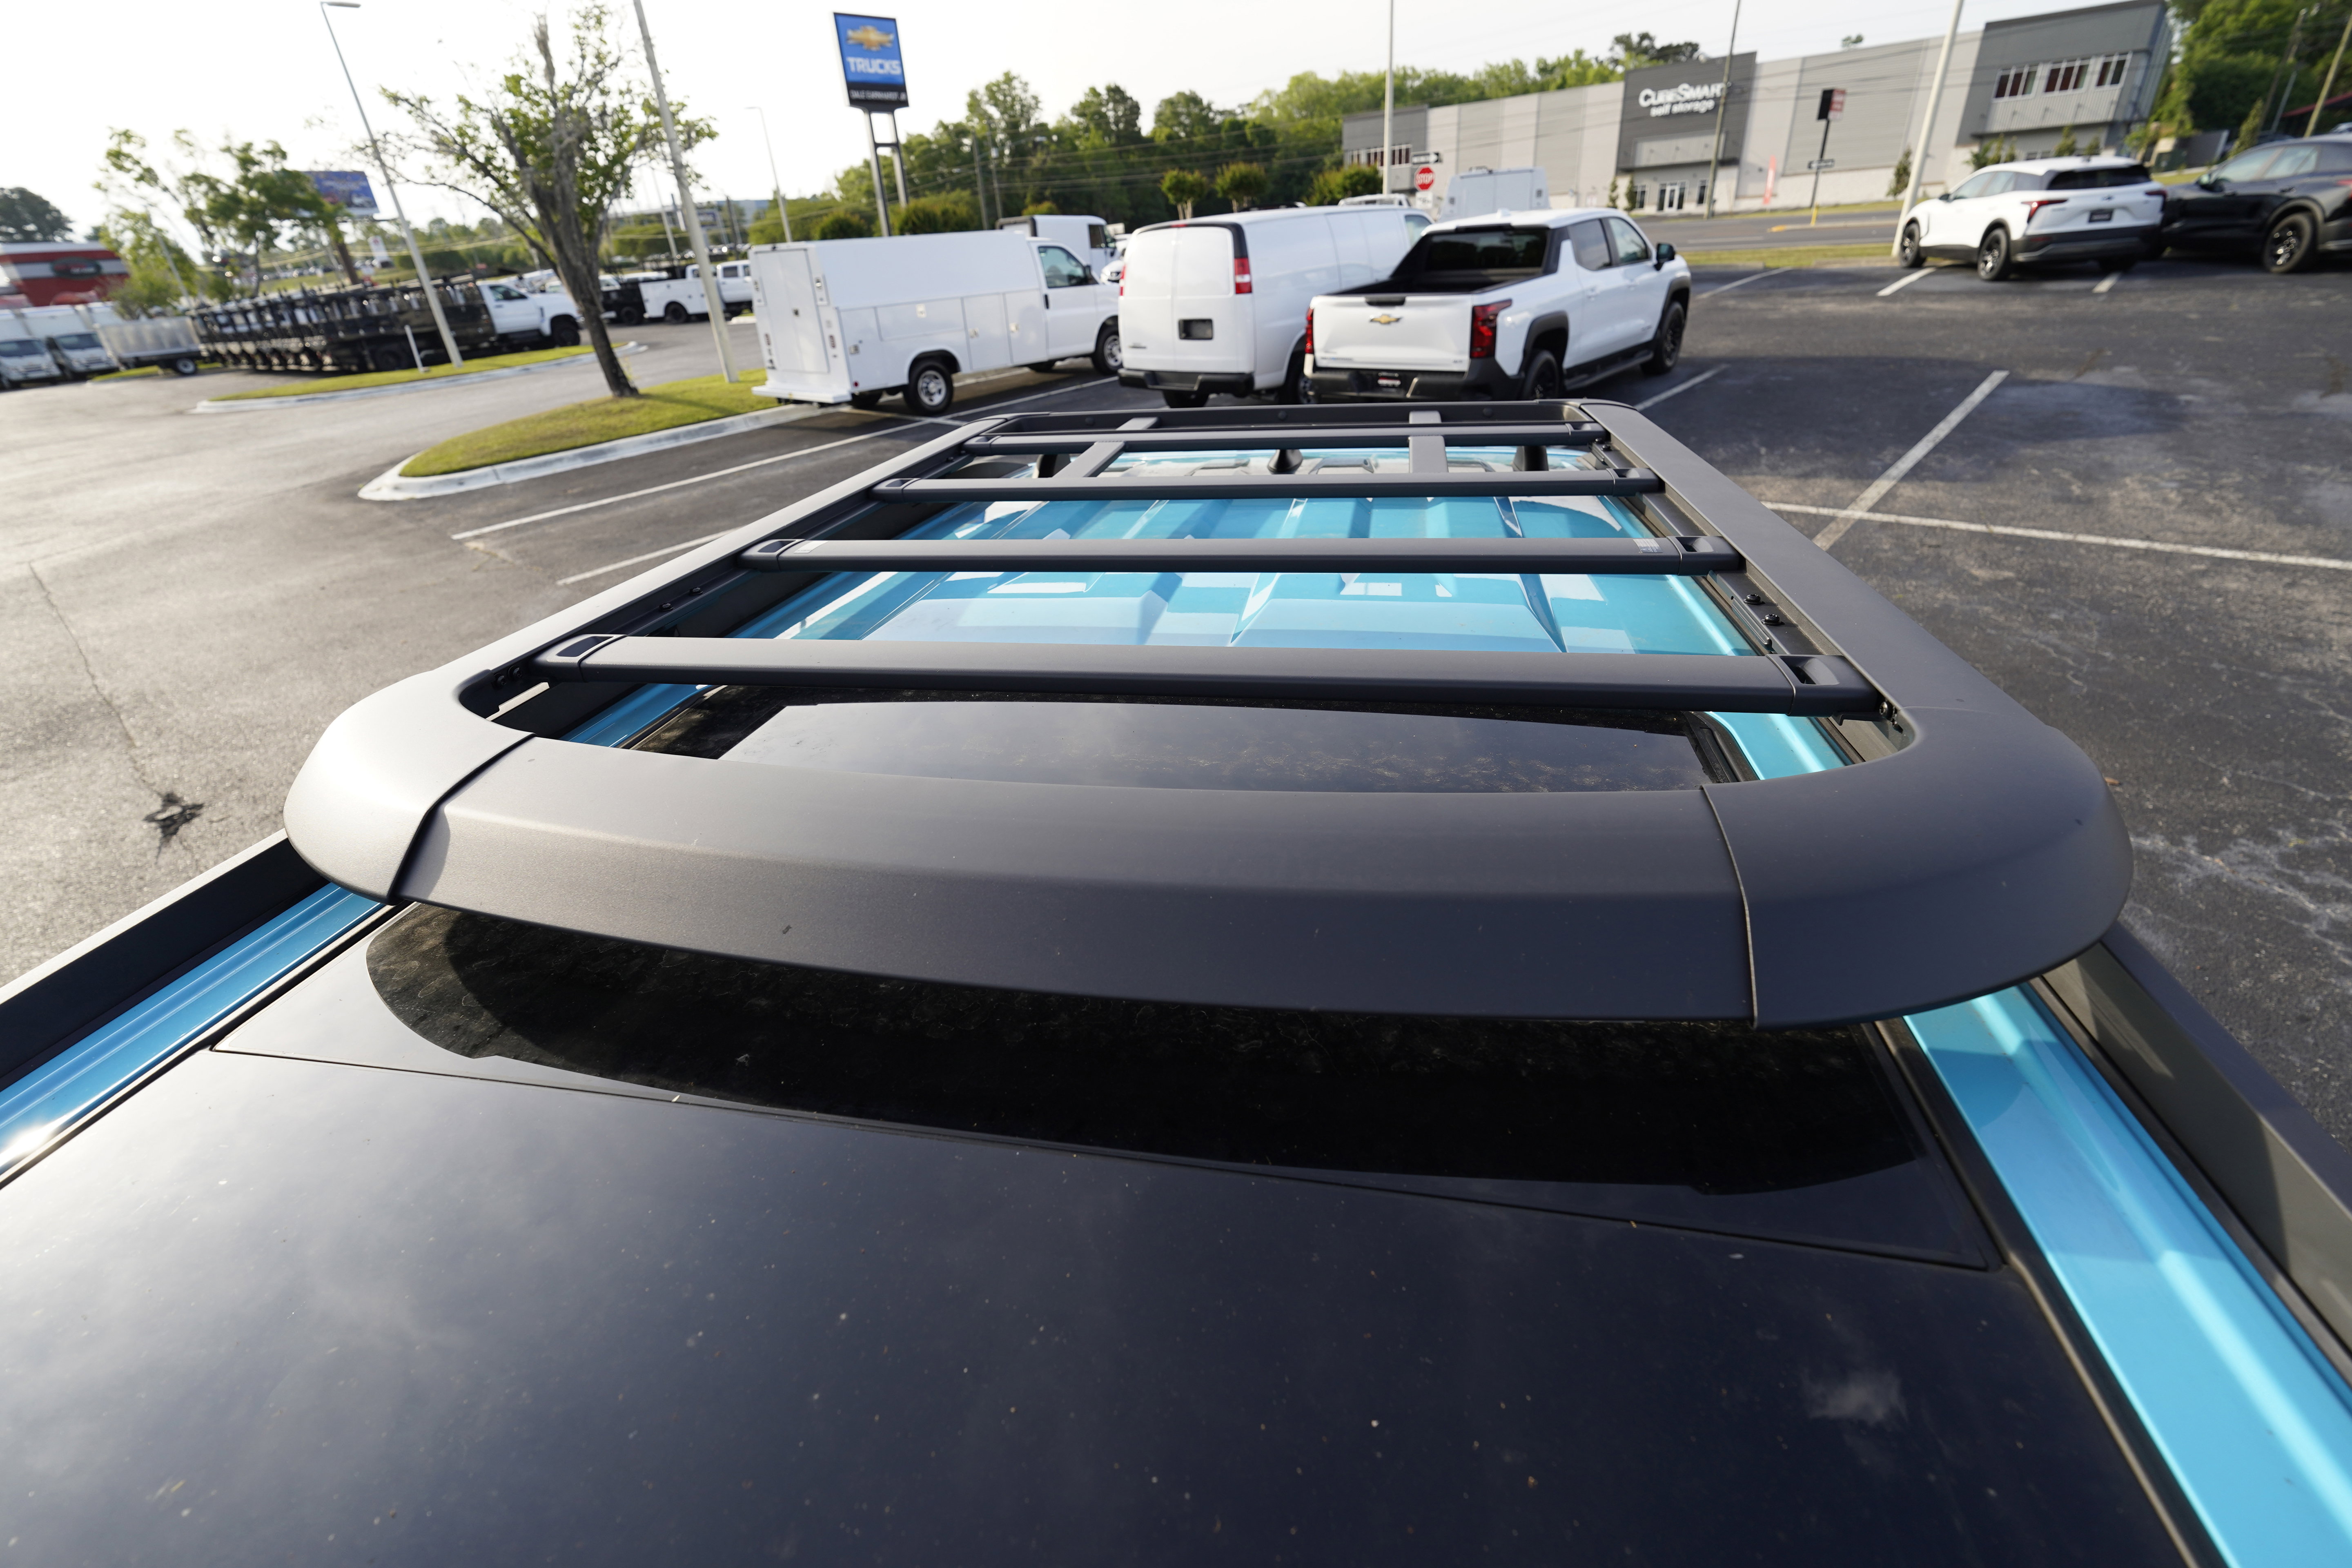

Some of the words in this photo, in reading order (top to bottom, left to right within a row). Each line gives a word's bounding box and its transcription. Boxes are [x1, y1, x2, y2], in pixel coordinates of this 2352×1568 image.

[846, 57, 902, 75] TRUCKS
[1671, 99, 1715, 114] storage
[1416, 173, 1433, 185] STOP
